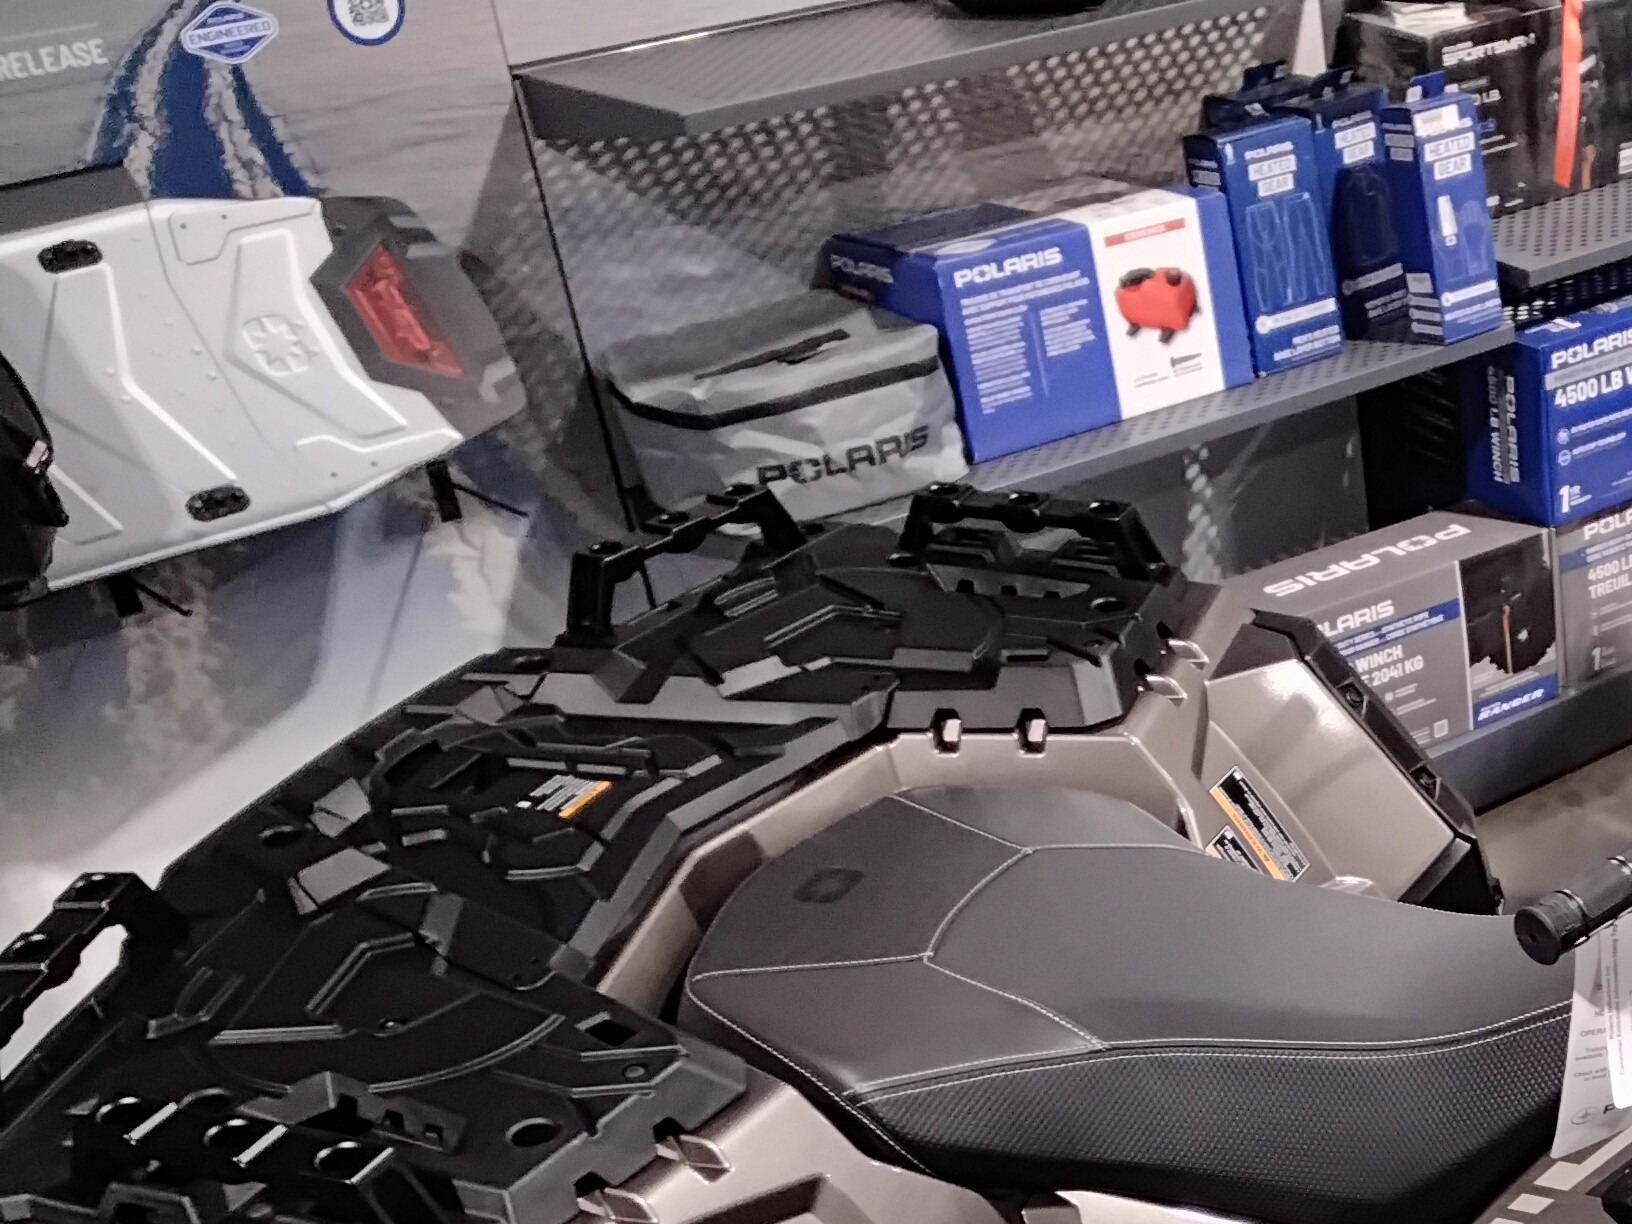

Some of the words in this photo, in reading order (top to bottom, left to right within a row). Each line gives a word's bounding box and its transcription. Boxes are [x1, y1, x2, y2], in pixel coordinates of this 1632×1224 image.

[188, 20, 273, 46] ENGINEERED
[0, 38, 109, 82] RELEASE
[1427, 134, 1473, 160] HEATED
[1436, 156, 1470, 178] GEAR
[953, 247, 1063, 288] POLARIS
[1555, 378, 1599, 407] 4500
[1600, 370, 1624, 395] LB
[1505, 375, 1521, 483] POLARIS
[757, 425, 929, 485] POLARIS
[1263, 523, 1473, 598] POLARIS
[1587, 562, 1620, 582] 4500
[1317, 600, 1395, 638] LARIS
[1355, 644, 1404, 672] WINCH
[1371, 664, 1404, 685] 2041
[1405, 655, 1425, 674] KG
[1477, 688, 1545, 721] RANGER
